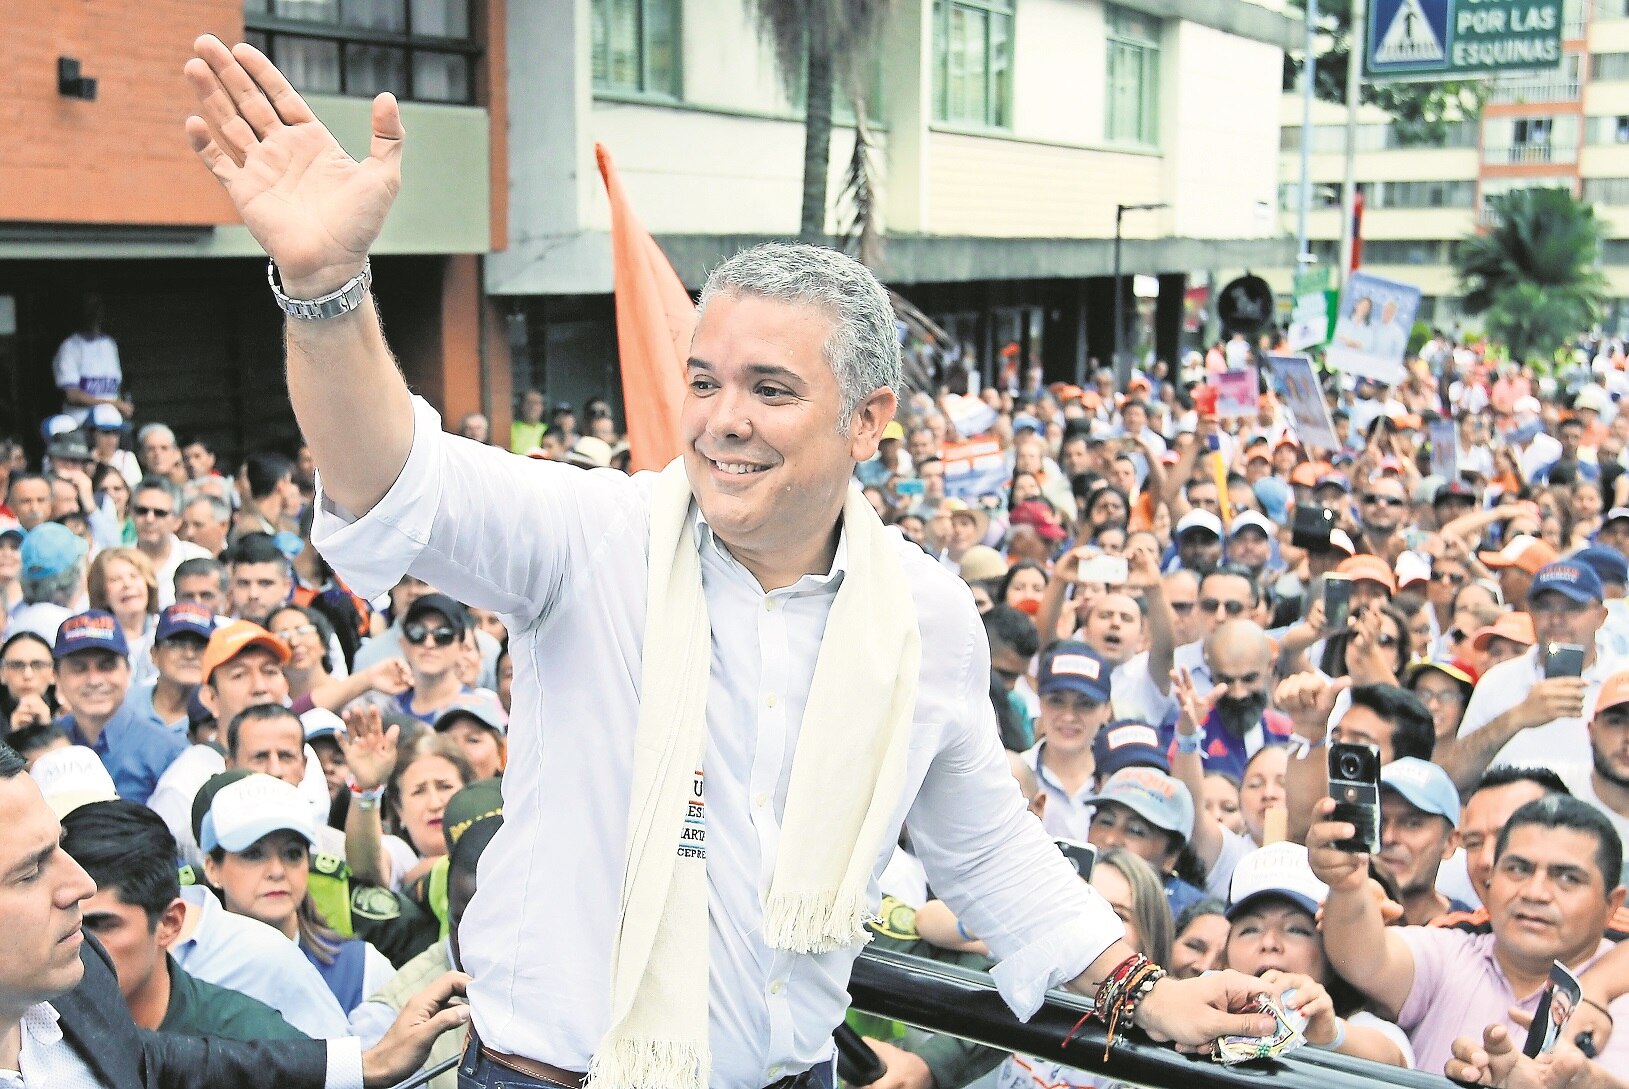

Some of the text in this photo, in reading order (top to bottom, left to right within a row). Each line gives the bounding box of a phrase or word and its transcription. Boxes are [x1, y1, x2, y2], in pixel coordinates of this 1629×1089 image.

[1457, 6, 1557, 35] POR LAS
[1452, 39, 1560, 67] ESQUINAS
[693, 780, 704, 797] U
